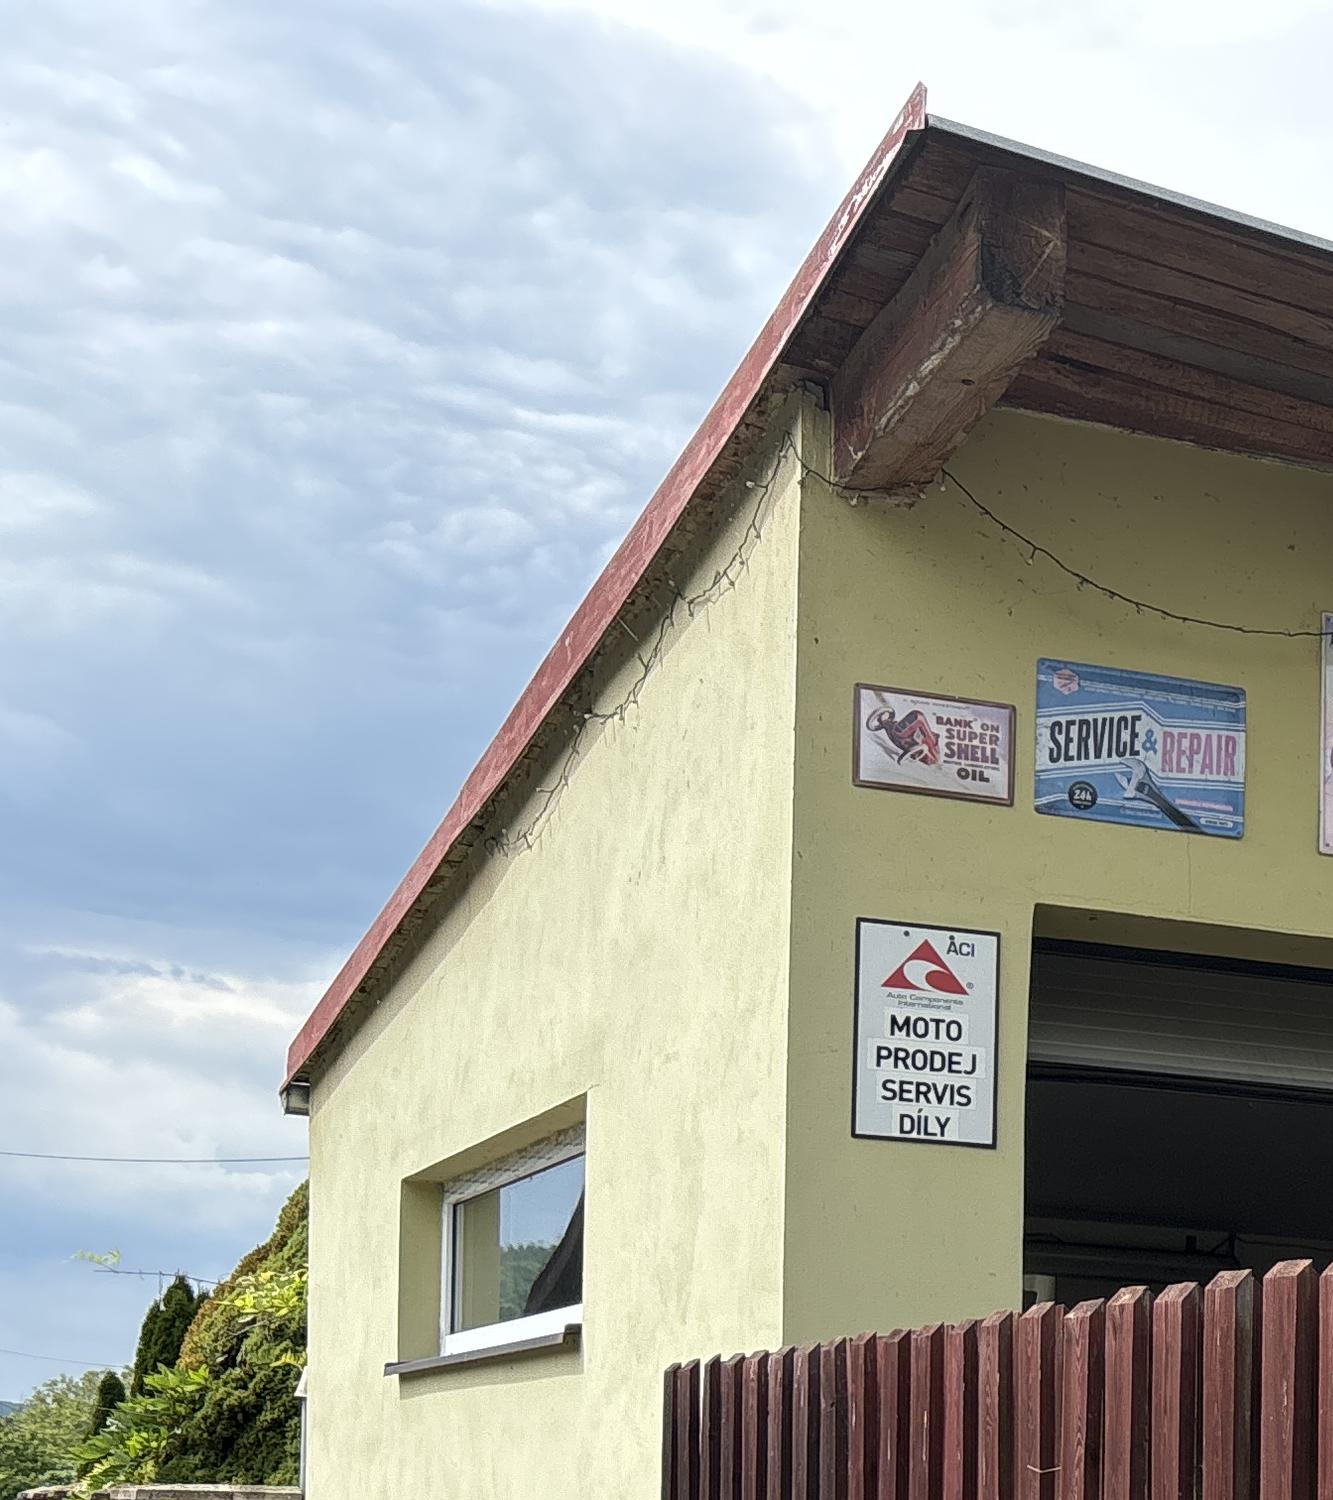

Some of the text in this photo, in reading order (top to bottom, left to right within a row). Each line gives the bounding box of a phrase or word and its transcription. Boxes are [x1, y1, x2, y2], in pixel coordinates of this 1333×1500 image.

[944, 727, 1000, 746] SUPER
[980, 722, 1000, 733] ON
[944, 741, 999, 765] SHELL
[1048, 714, 1238, 777] SERVICE & REPAIR
[956, 767, 990, 783] OIL
[889, 1014, 963, 1042] MOTO
[875, 1045, 978, 1076] PRODEJ
[881, 1079, 972, 1107] SERVIS
[899, 1108, 951, 1138] DÍLY
